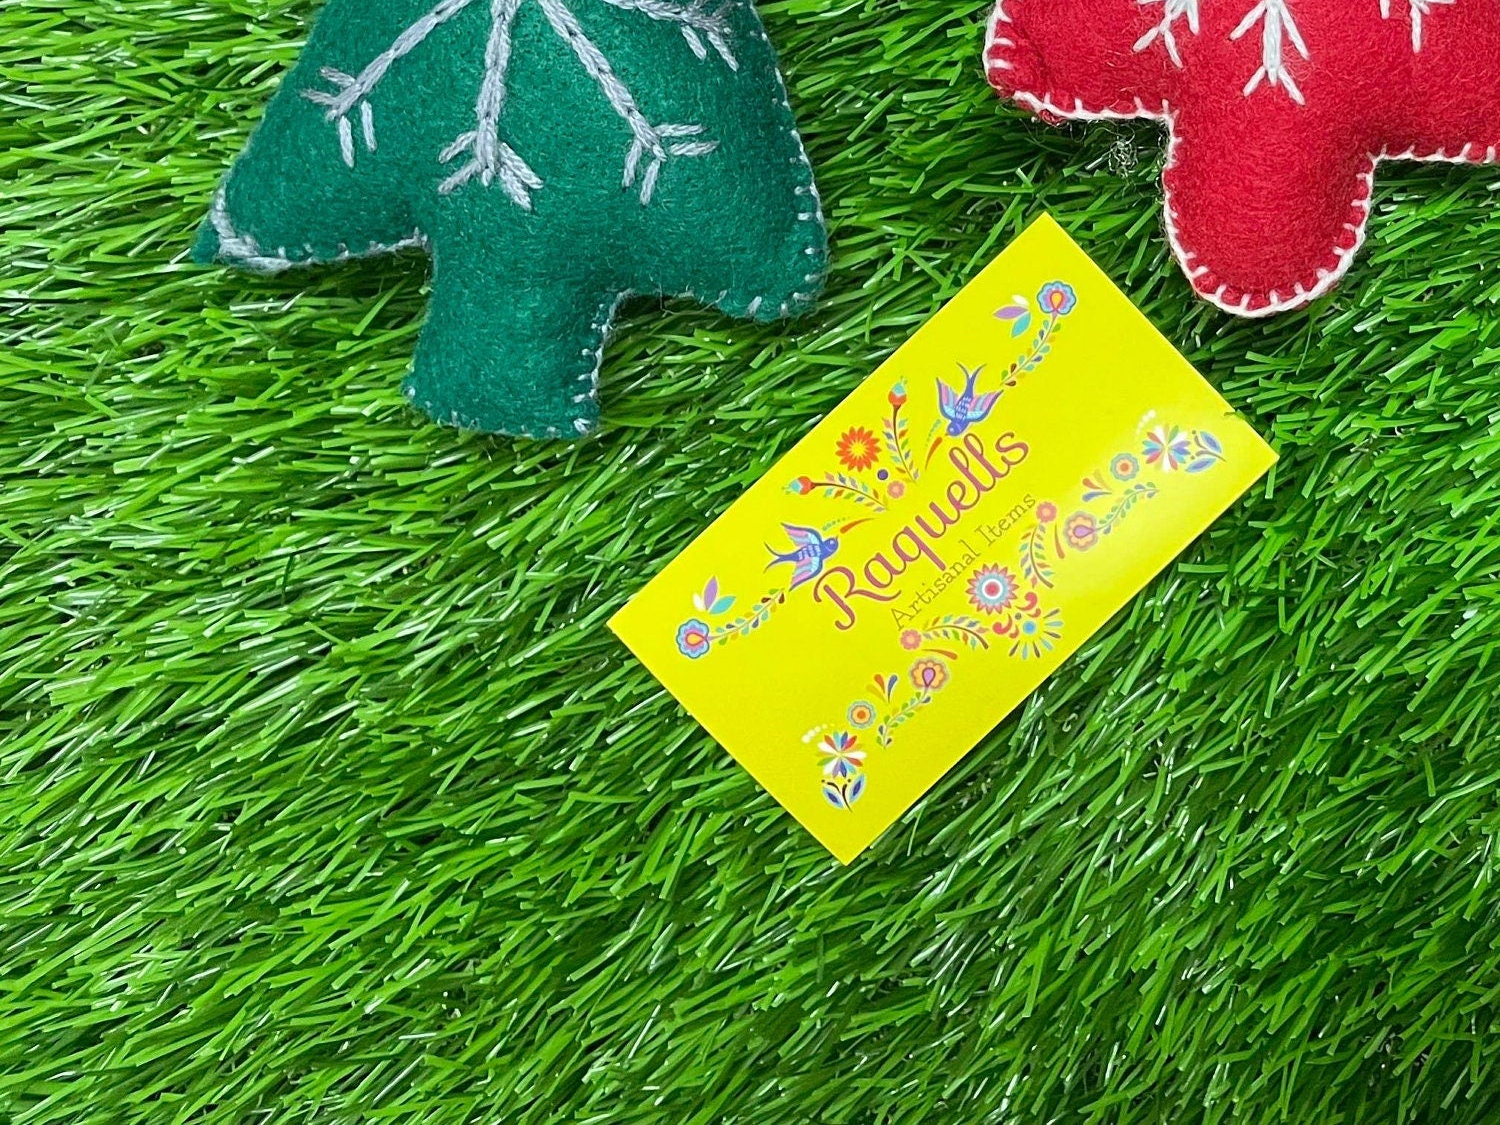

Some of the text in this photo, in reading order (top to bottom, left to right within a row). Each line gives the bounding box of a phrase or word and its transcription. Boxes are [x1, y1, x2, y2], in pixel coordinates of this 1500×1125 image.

[813, 432, 1029, 630] Raquells
[890, 493, 1036, 631] Artisanal Items
